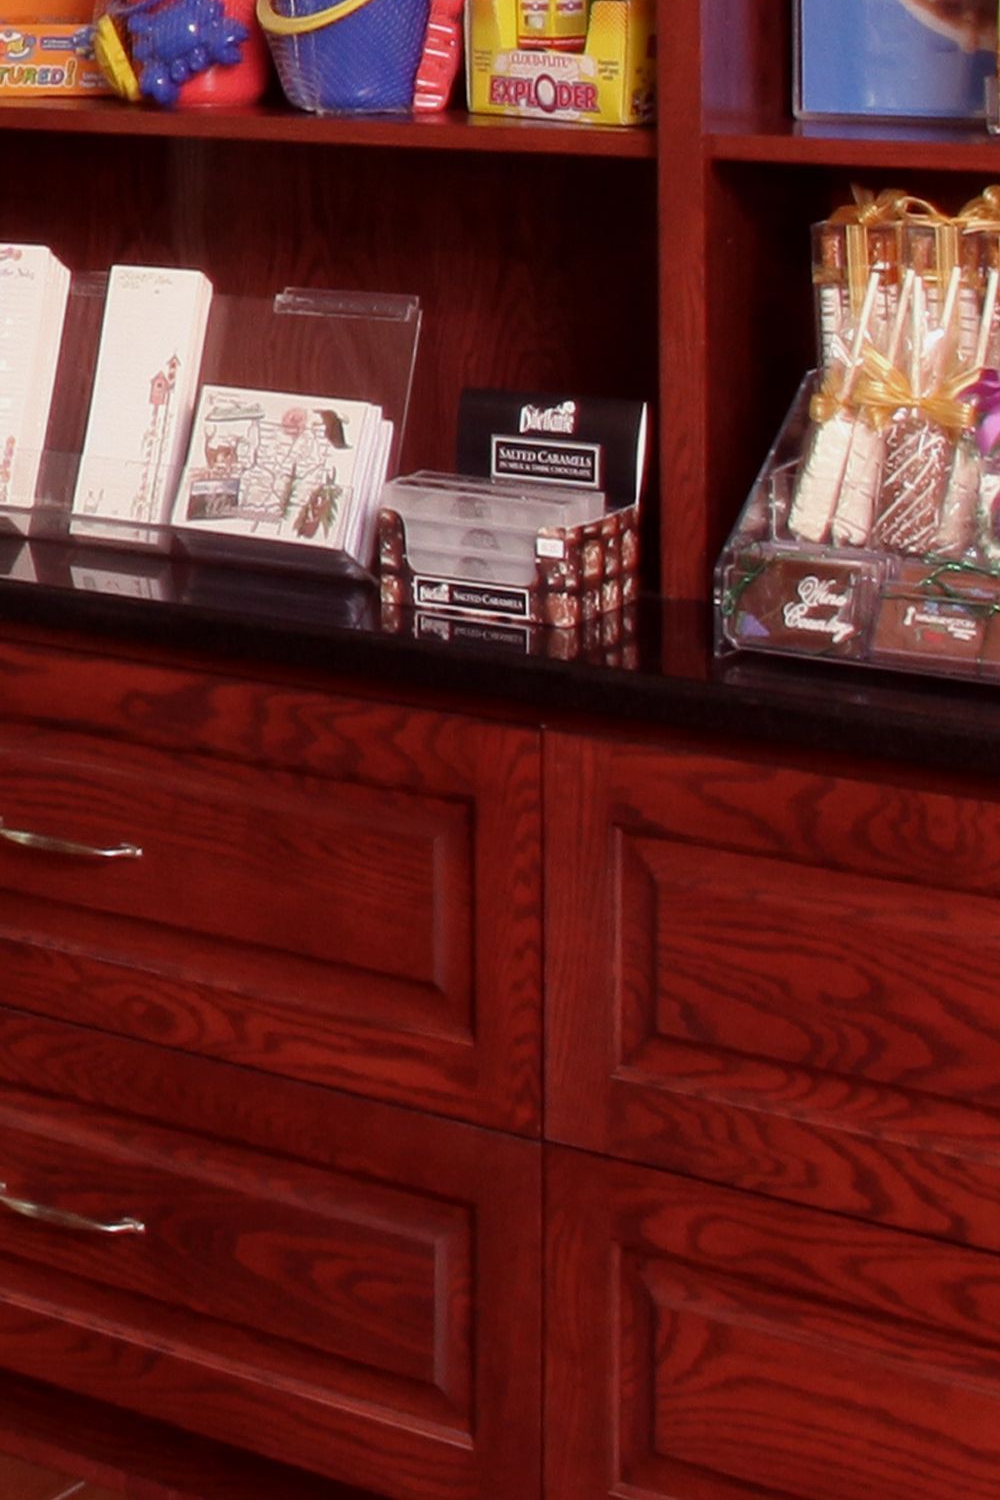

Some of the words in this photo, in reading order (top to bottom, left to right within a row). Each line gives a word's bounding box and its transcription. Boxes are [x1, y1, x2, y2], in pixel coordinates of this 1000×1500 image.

[0, 57, 77, 88] TURED!
[489, 73, 600, 113] EXPLODER
[498, 446, 536, 461] SALTED
[537, 449, 592, 467] CARAMELS
